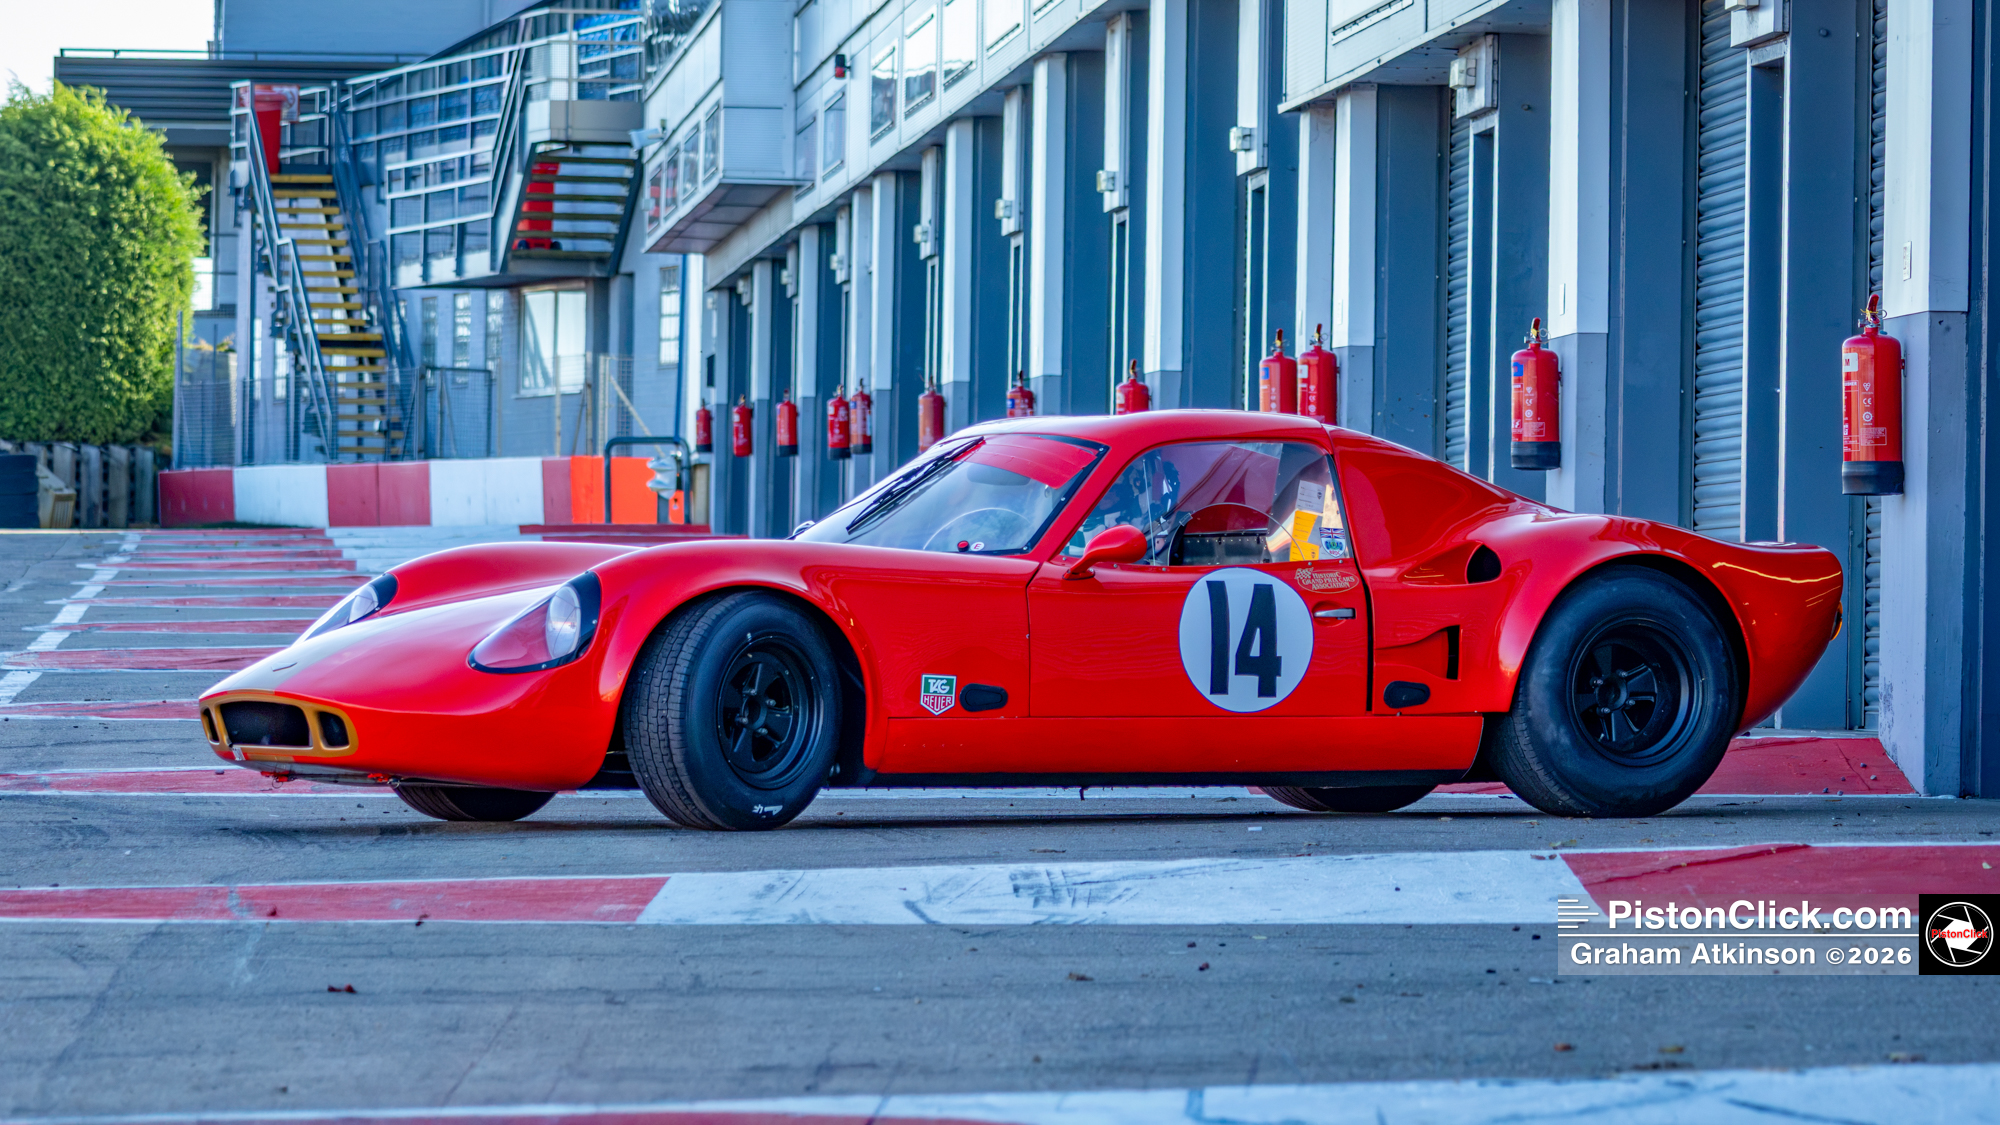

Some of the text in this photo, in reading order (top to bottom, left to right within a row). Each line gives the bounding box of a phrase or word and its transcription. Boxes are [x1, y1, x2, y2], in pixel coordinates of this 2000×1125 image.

[1302, 575, 1355, 586] GRAND PRIX CARS
[1312, 571, 1341, 579] HISTORIC
[1311, 580, 1351, 591] ASSOCIATION
[1206, 580, 1282, 698] 14
[928, 678, 950, 694] TAG
[923, 695, 952, 712] HEUER
